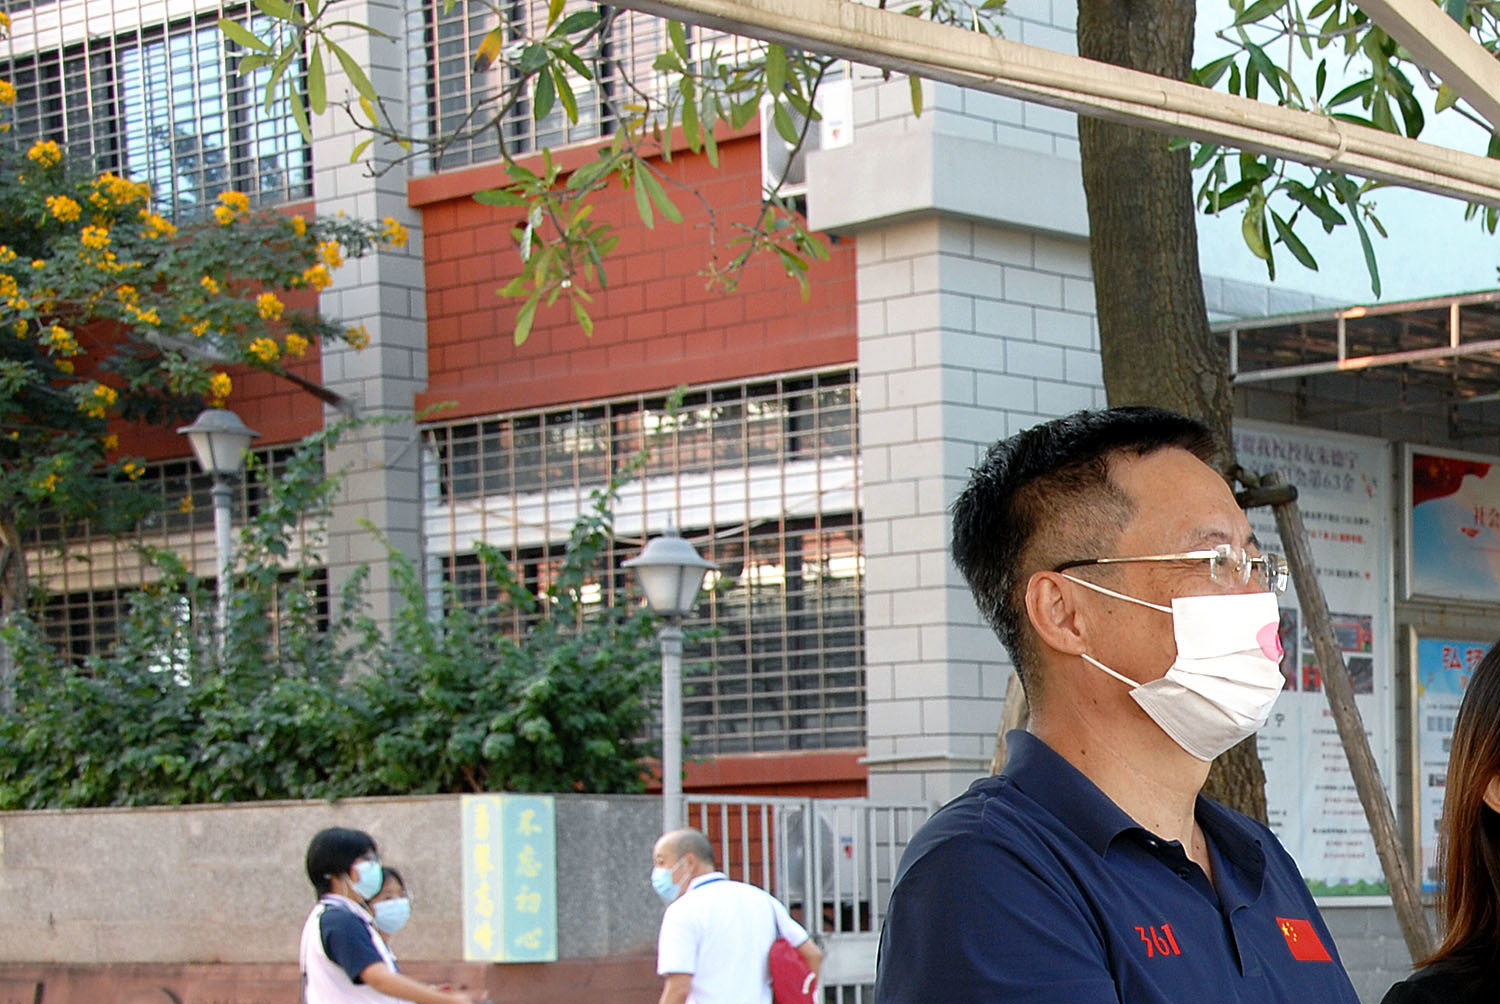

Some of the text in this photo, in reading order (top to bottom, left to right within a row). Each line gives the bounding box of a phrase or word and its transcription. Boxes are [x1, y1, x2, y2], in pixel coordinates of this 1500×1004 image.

[515, 808, 543, 949] 不忘初心
[1133, 922, 1182, 958] 361
